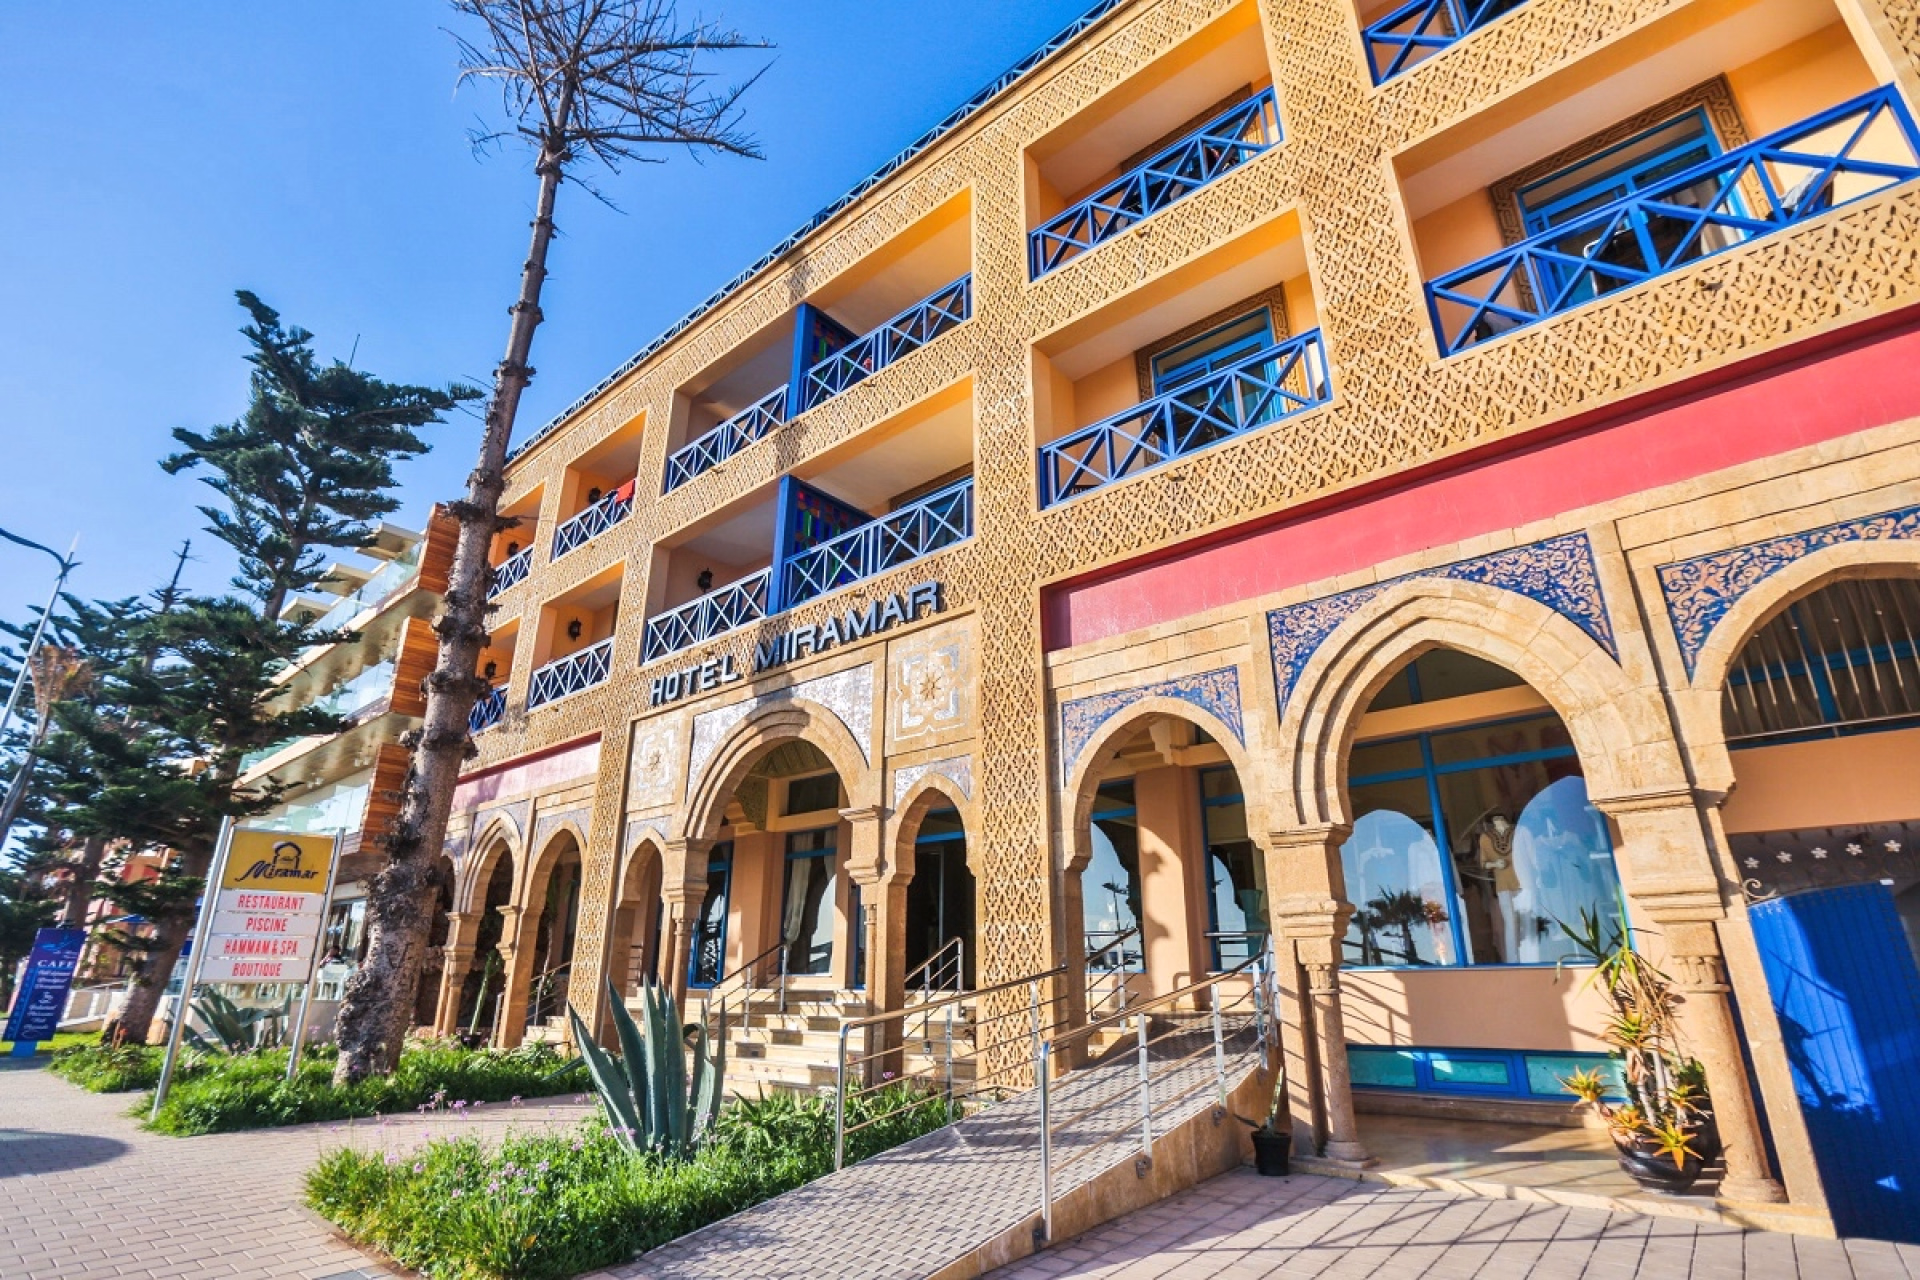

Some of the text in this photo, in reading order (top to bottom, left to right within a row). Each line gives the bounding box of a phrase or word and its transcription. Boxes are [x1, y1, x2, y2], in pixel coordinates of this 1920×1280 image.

[650, 580, 940, 706] HOTEL MIRAMAR
[234, 860, 319, 882] Miramar
[237, 894, 305, 910] RESTAURANT
[245, 917, 289, 932] PISCINE
[223, 939, 270, 955] HAMMAM
[280, 940, 298, 956] SPA
[231, 963, 283, 977] BOUTIQUE
